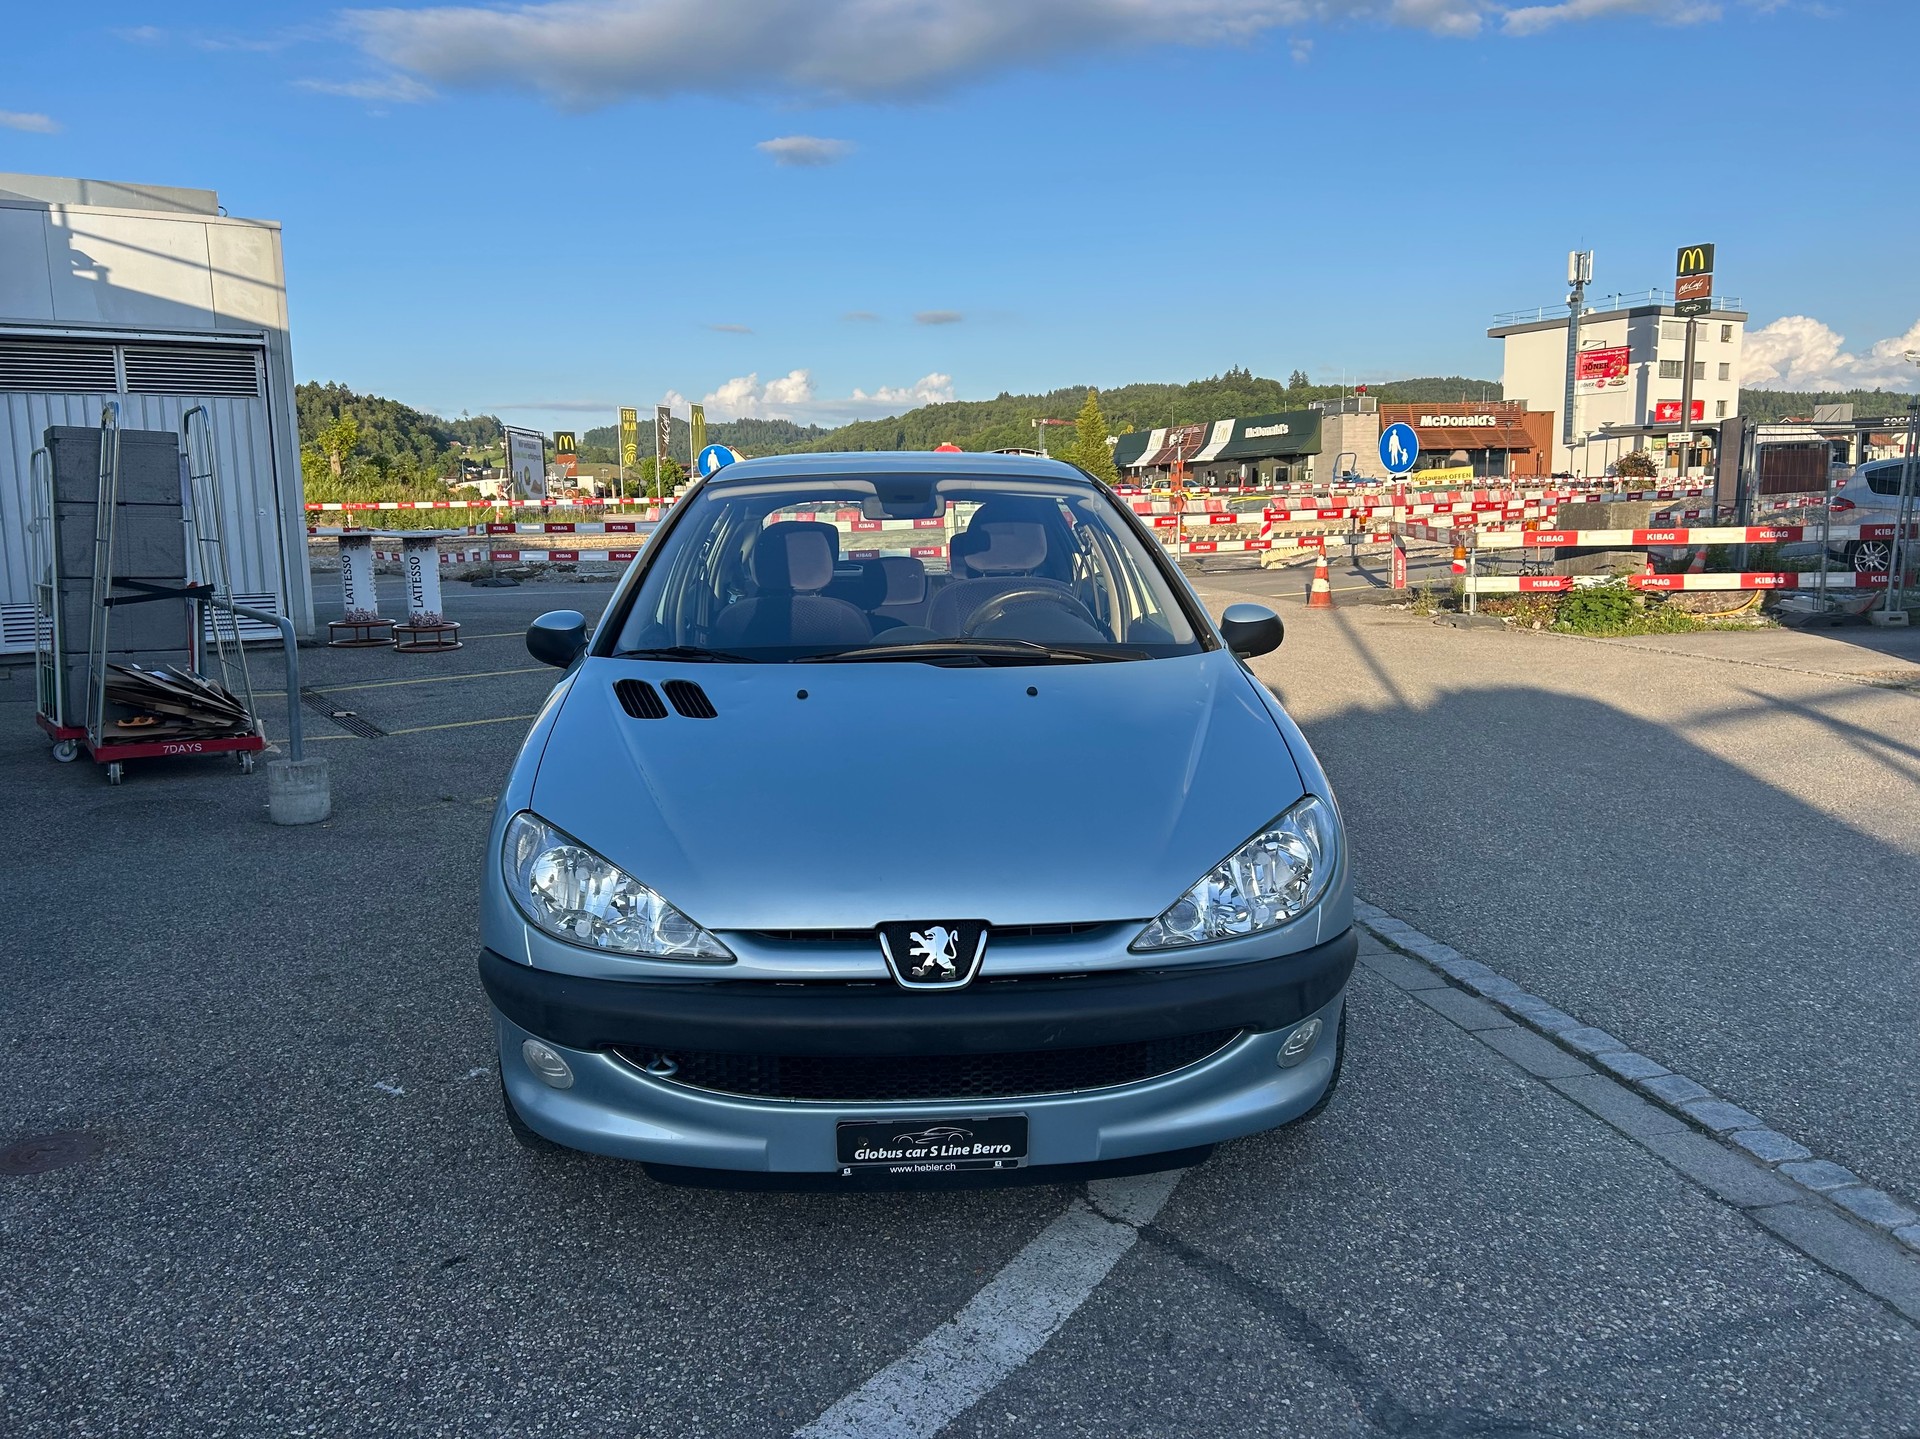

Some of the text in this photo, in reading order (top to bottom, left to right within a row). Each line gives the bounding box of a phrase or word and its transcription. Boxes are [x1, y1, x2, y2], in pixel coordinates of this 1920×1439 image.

[622, 410, 636, 421] FREE
[1420, 414, 1497, 427] McDonald's
[1244, 423, 1289, 439] McDonald's
[1448, 472, 1472, 480] OFFEN
[1536, 535, 1564, 543] KIBAG
[1646, 533, 1675, 541] KIBAG
[342, 555, 355, 605] LATTESSO
[409, 556, 424, 608] LATTESSO
[1532, 579, 1560, 587] KIBAG
[1641, 578, 1670, 586] KIBAG
[1871, 575, 1900, 583] KIBG
[163, 743, 202, 754] 7DAYS
[854, 1143, 1011, 1160] Globus car S Line Berro
[889, 1162, 956, 1174] www.hebler.ch
